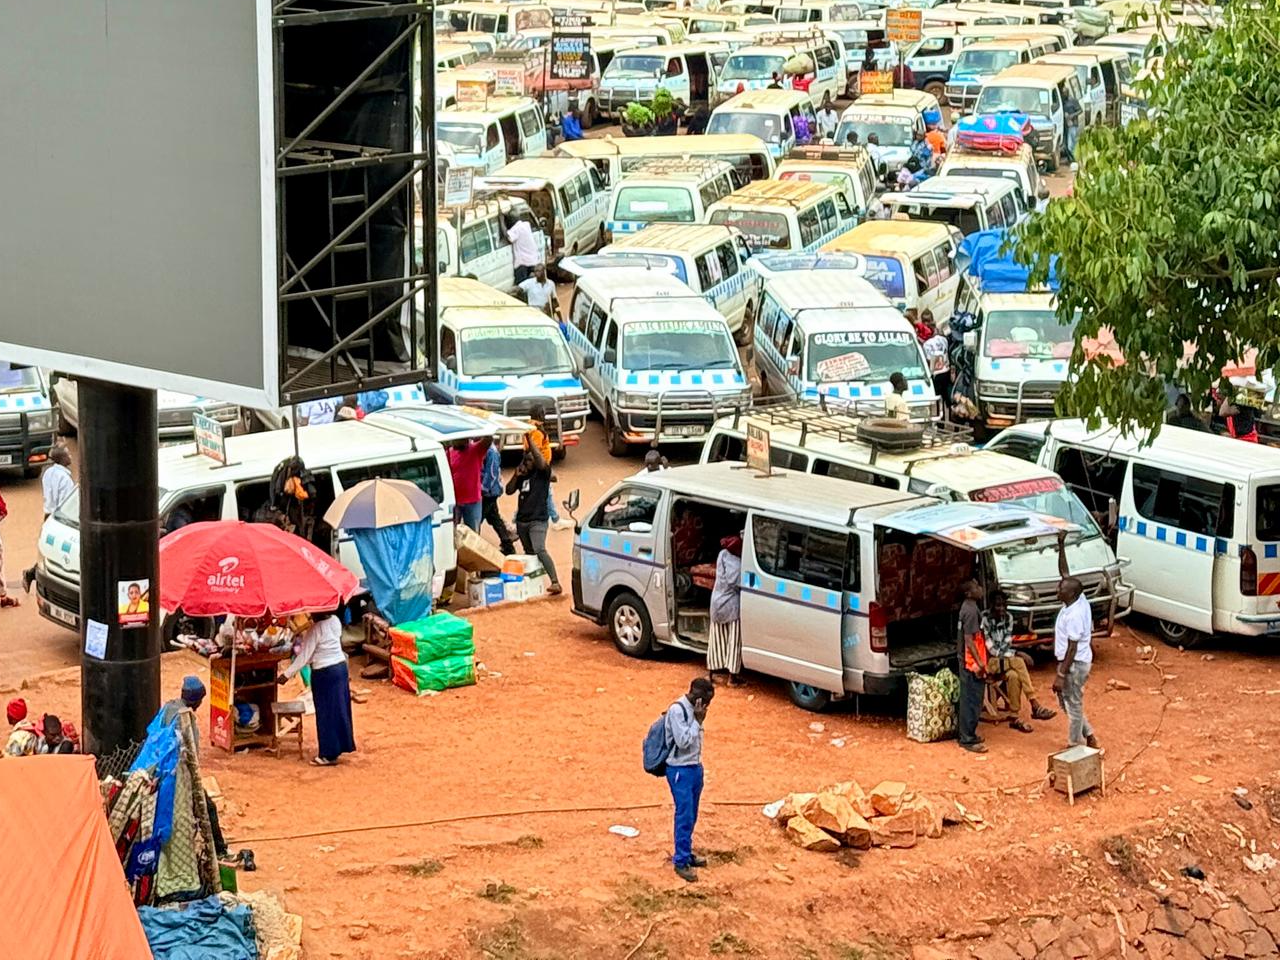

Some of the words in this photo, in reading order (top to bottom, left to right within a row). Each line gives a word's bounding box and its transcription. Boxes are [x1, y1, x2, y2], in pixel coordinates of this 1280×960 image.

[814, 333, 846, 345] GLORY
[848, 333, 861, 343] BE
[862, 333, 877, 344] TO
[878, 333, 910, 344] ALLAH
[207, 573, 245, 587] airtel
[210, 585, 240, 594] money
